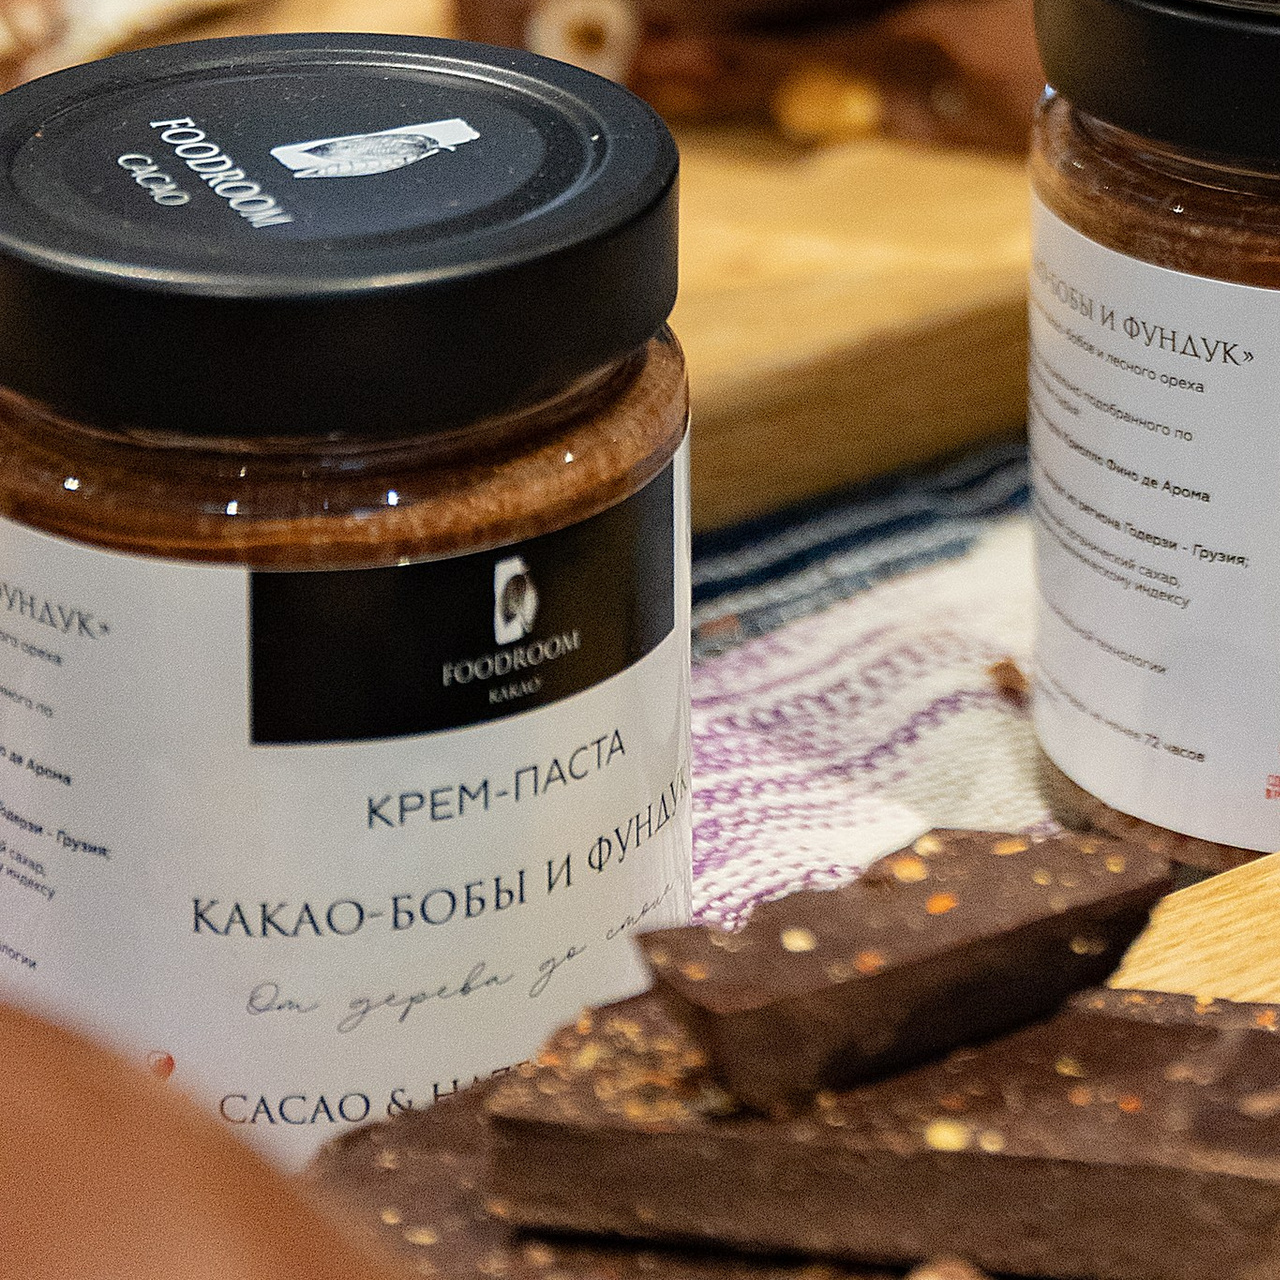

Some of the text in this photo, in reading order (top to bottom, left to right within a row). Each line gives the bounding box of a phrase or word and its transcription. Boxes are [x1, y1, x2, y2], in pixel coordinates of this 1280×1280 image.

[116, 152, 191, 208] CACAO
[149, 116, 296, 230] FOODROOM
[1099, 304, 1117, 332] И
[1122, 315, 1255, 367] ФУНДУК»
[1159, 371, 1206, 394] ореха
[1174, 429, 1194, 442] по
[1161, 479, 1211, 503] Арома
[1192, 543, 1250, 569] Грузия;
[442, 628, 582, 687] FOODROOM
[366, 729, 626, 830] КРЕМ-ПАСТА
[192, 870, 528, 939] КАКАО-БОБЫ
[546, 852, 573, 895] И
[219, 1091, 371, 1126] CACAO
